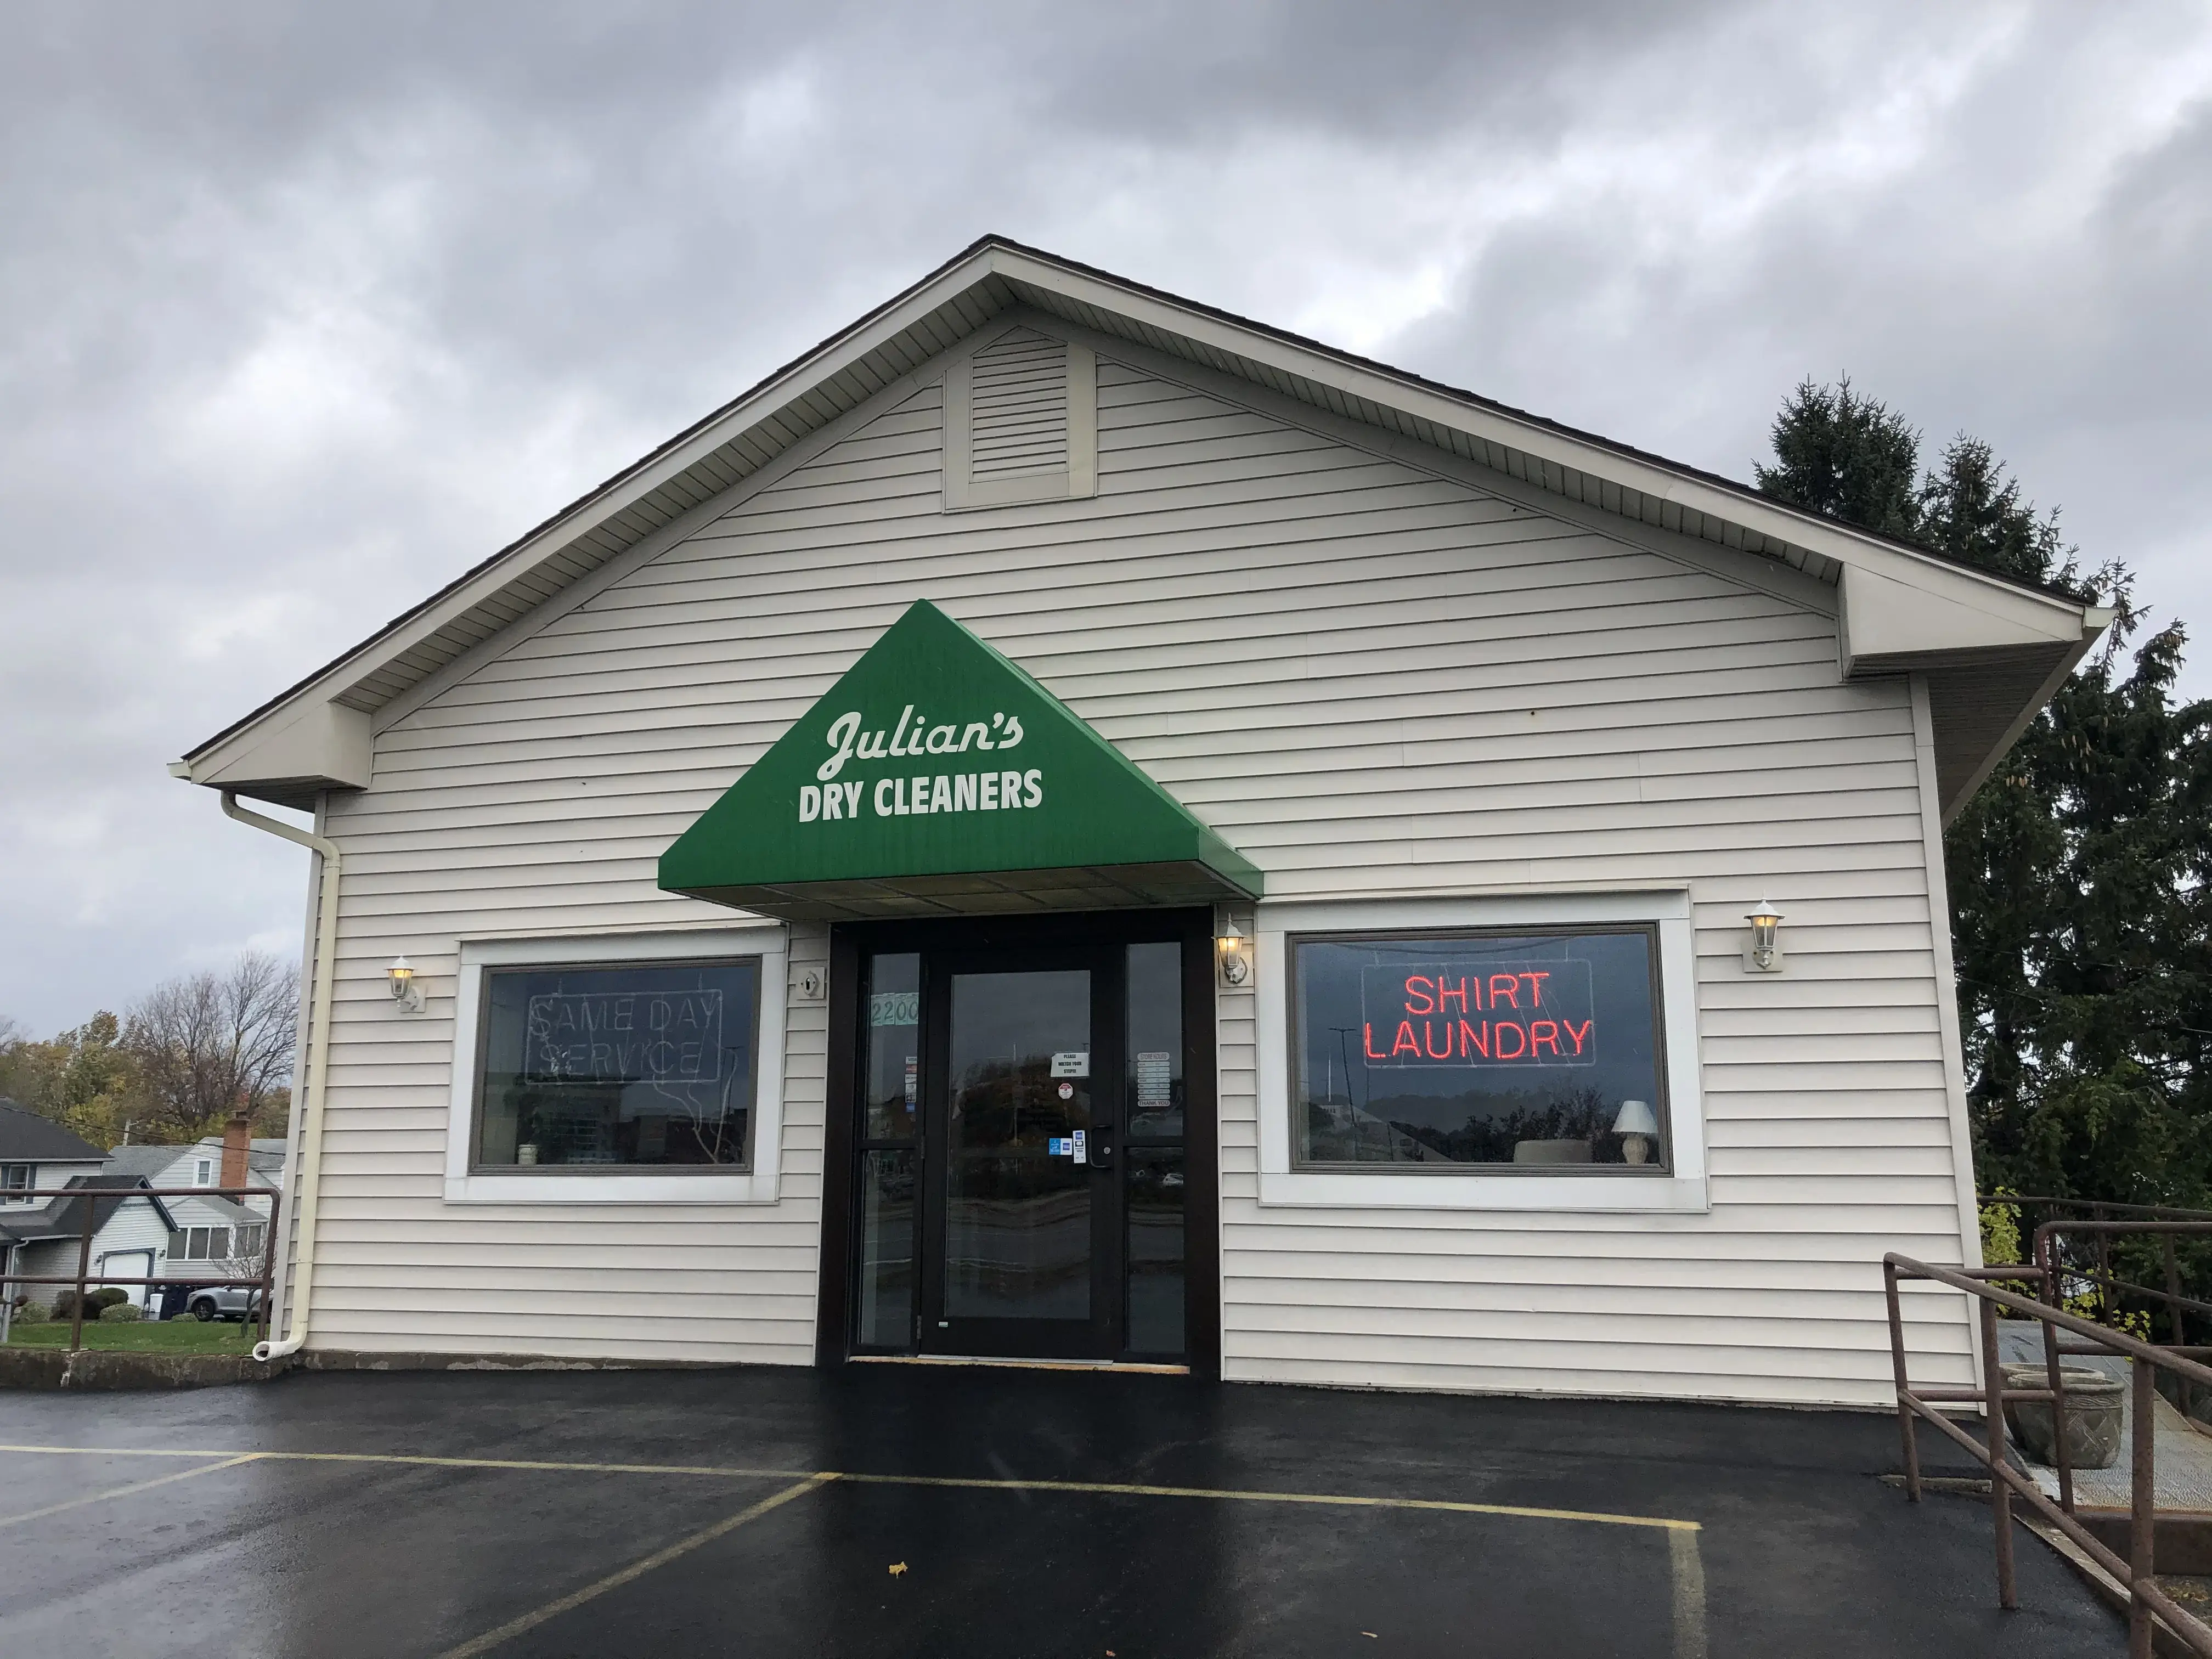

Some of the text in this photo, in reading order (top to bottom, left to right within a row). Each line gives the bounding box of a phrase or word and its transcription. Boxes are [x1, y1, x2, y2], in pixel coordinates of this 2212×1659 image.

[817, 704, 1024, 781] Julian's
[799, 769, 1042, 822] DRY CLEANERS
[872, 1001, 918, 1022] 2200
[1404, 972, 1550, 1015] SHIRT
[530, 997, 718, 1036] SAME DAY
[540, 1040, 701, 1076] SERVICE
[1364, 1019, 1592, 1059] LAUNDRY
